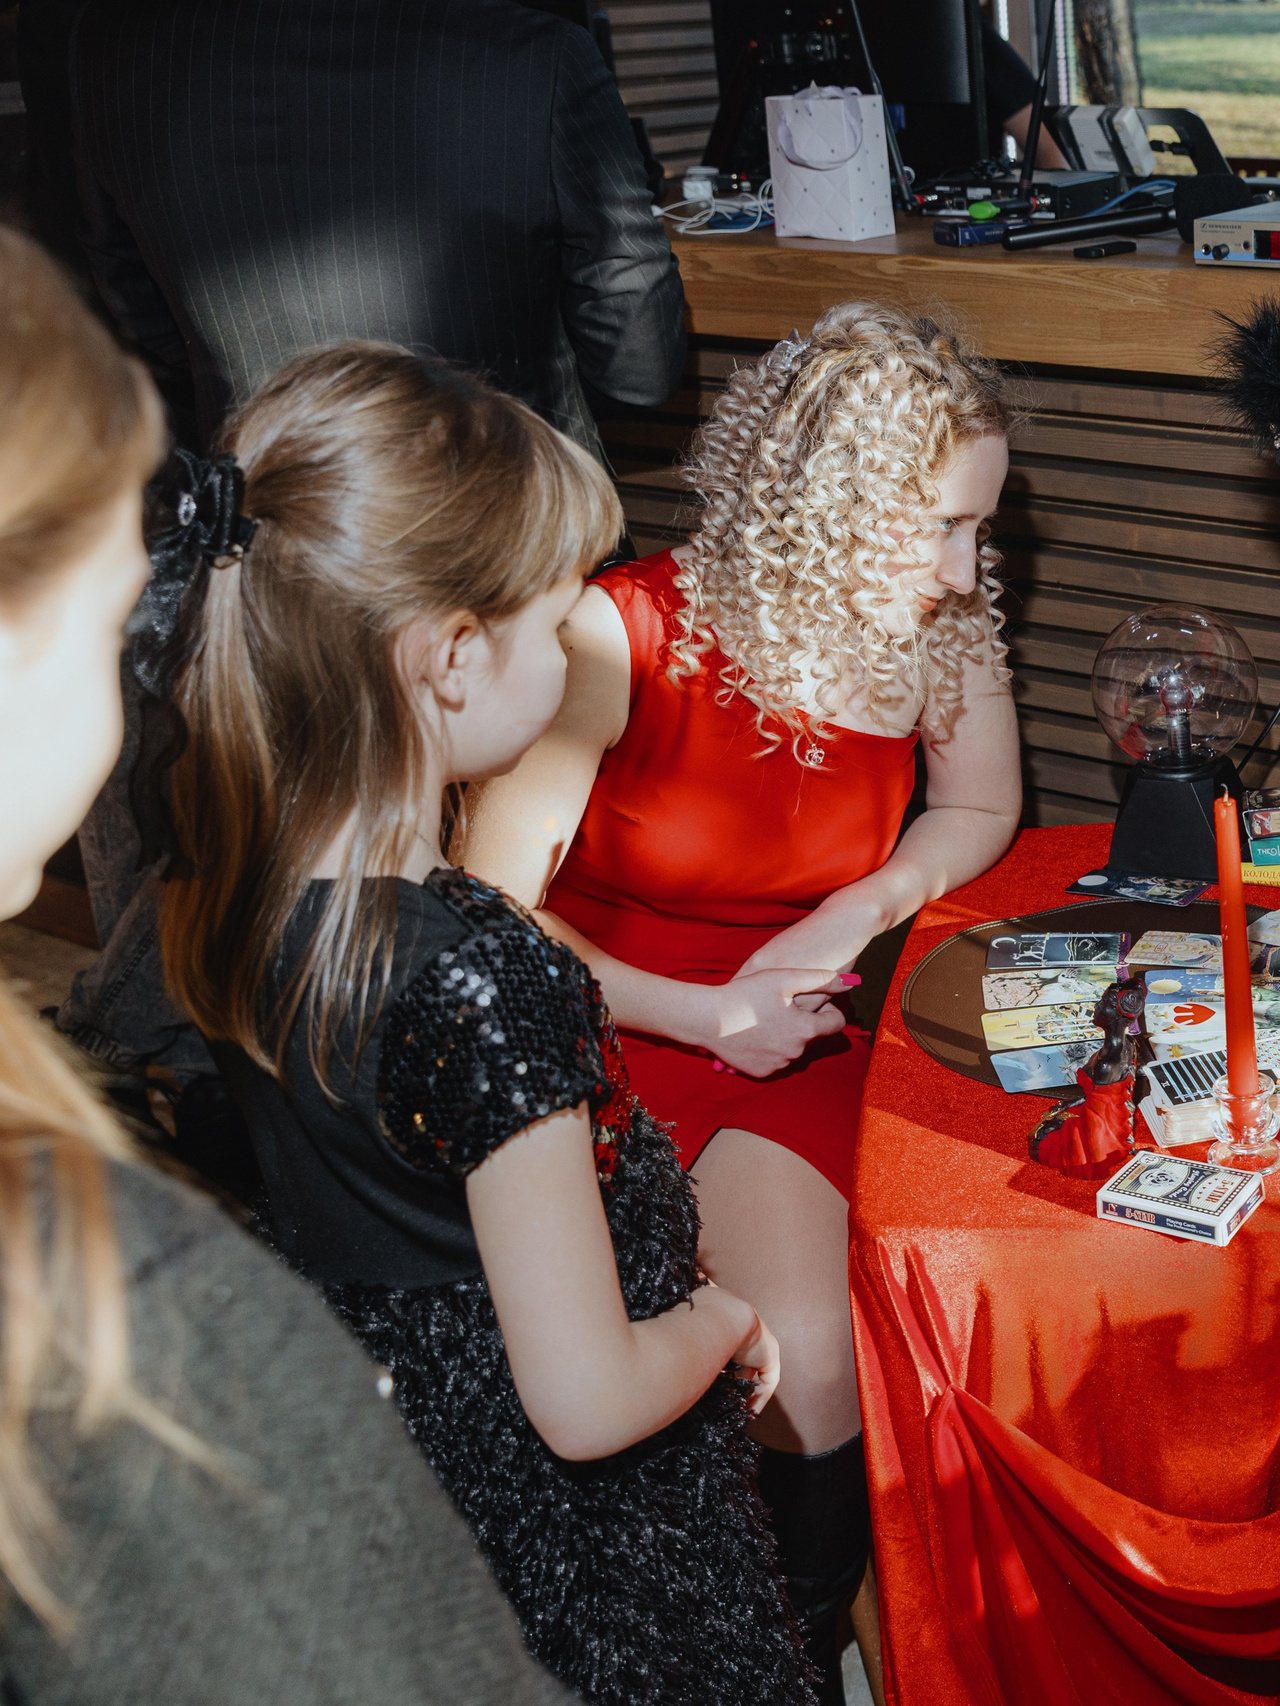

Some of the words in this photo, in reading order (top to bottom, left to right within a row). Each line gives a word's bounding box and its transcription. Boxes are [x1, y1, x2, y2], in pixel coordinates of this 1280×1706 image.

[1257, 848, 1274, 856] THE
[1165, 1217, 1183, 1227] Playing
[1183, 1221, 1197, 1230] Cards
